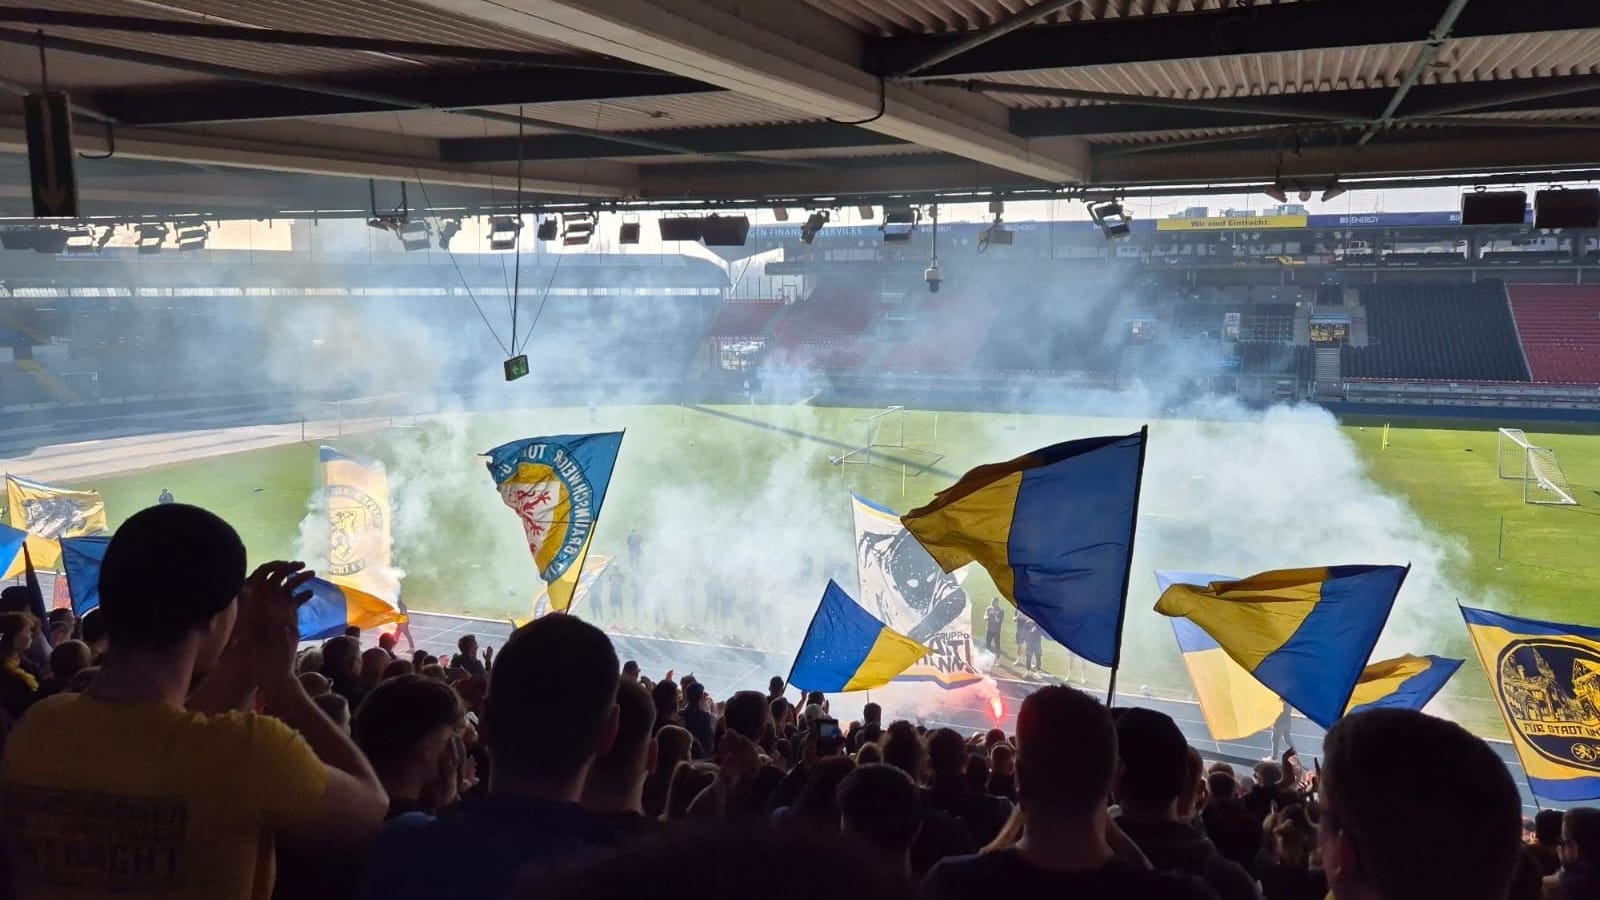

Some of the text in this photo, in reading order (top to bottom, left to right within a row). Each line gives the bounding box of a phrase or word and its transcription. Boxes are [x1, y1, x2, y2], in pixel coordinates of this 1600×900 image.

[1190, 219, 1205, 227] Wir
[1207, 219, 1225, 227] sind
[1547, 725, 1582, 735] STADT
